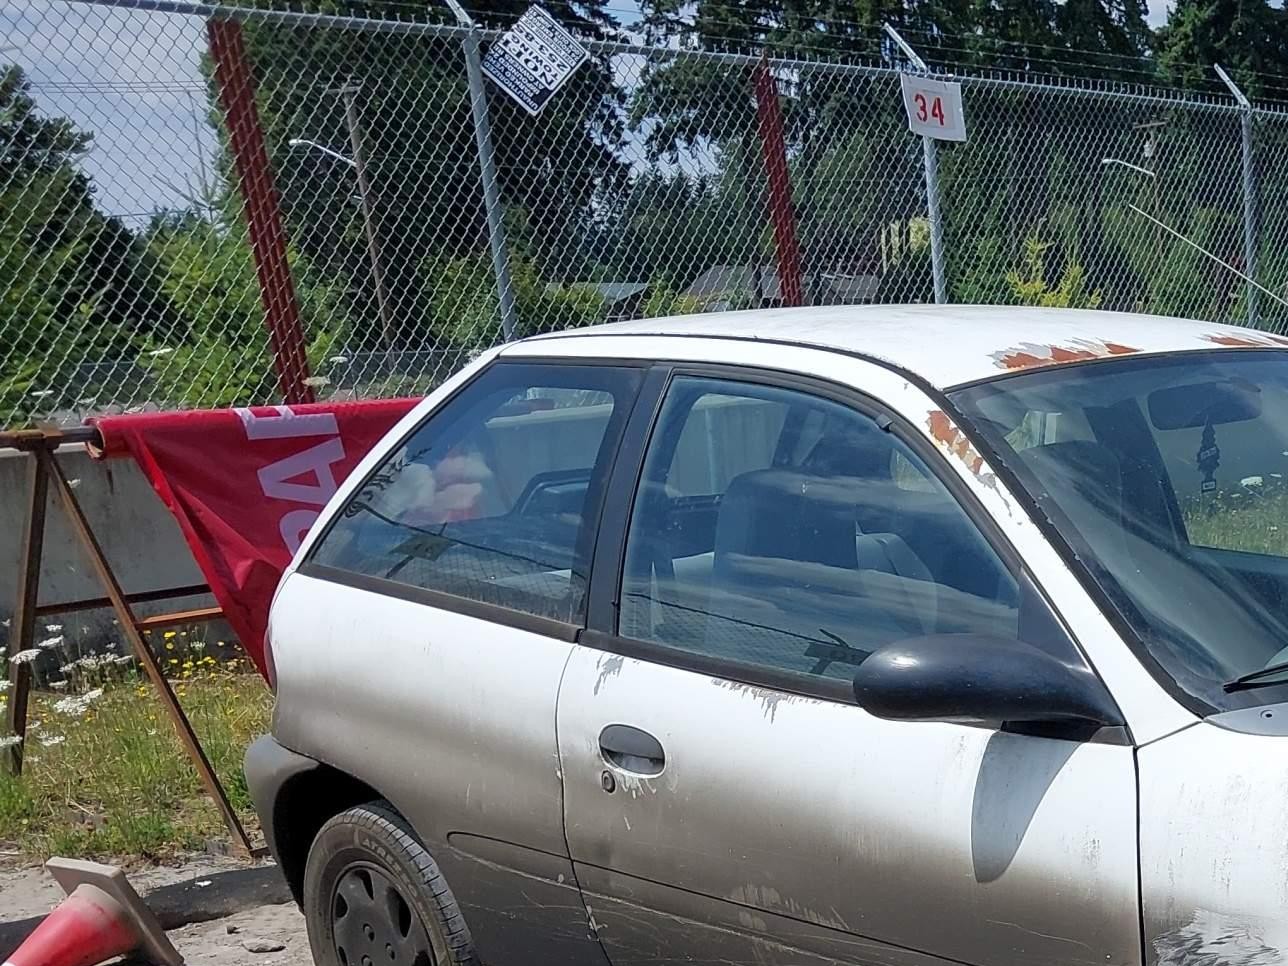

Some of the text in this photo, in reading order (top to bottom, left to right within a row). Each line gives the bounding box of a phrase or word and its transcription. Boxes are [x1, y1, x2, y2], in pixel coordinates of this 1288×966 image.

[509, 33, 560, 81] TOWING
[513, 21, 568, 73] 253-85
[552, 35, 571, 54] HOUR
[497, 55, 540, 95] IMPOUNDED
[503, 52, 535, 82] OWNERS
[504, 69, 534, 97] PARKED
[483, 59, 538, 110] UNAUTHORIZED
[533, 79, 544, 90] AT
[914, 93, 945, 126] 34
